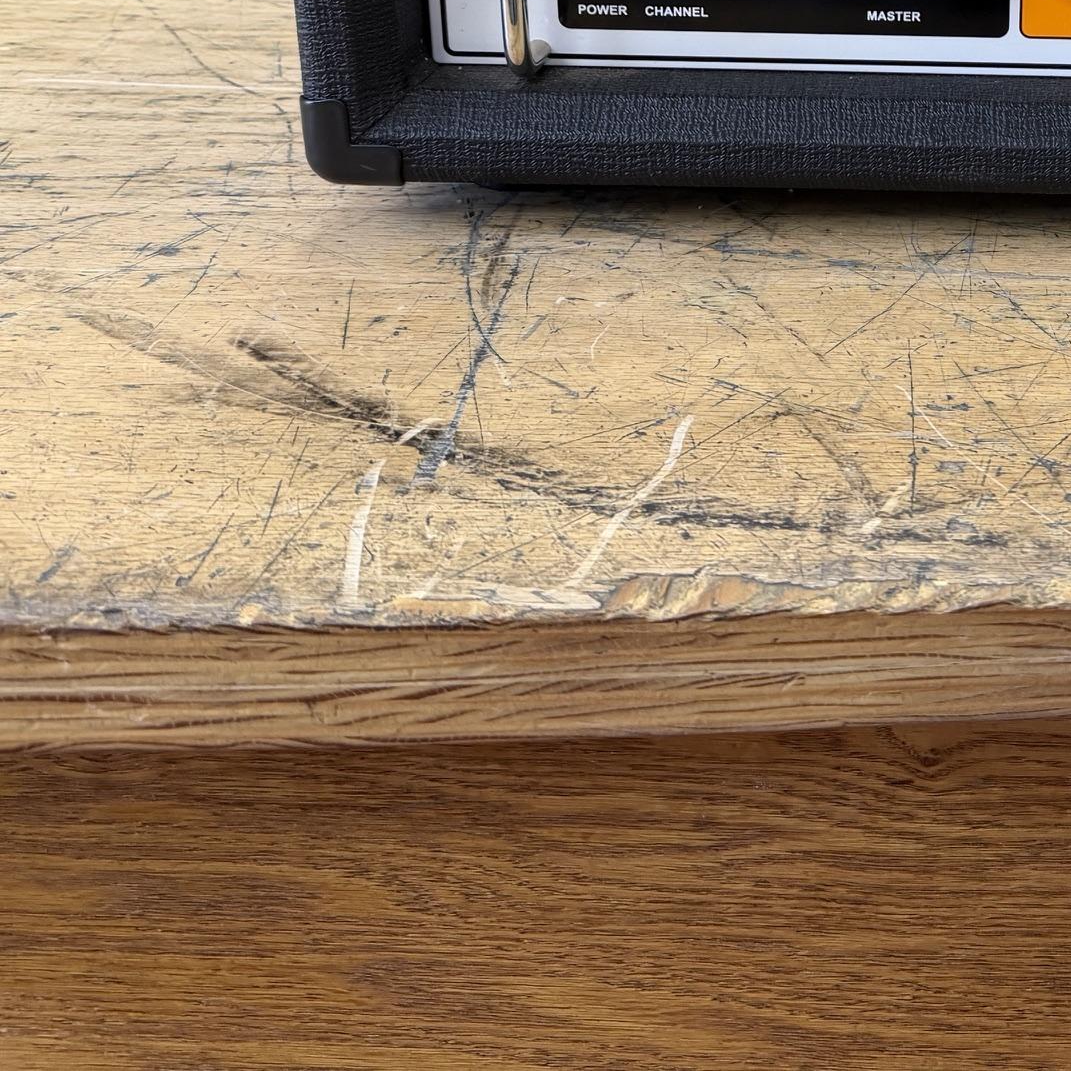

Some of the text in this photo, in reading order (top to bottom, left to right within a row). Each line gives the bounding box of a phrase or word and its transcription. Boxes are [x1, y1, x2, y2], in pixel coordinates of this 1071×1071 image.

[577, 3, 628, 16] POWER
[644, 5, 709, 18] CHANNEL
[866, 10, 921, 22] MASTER
